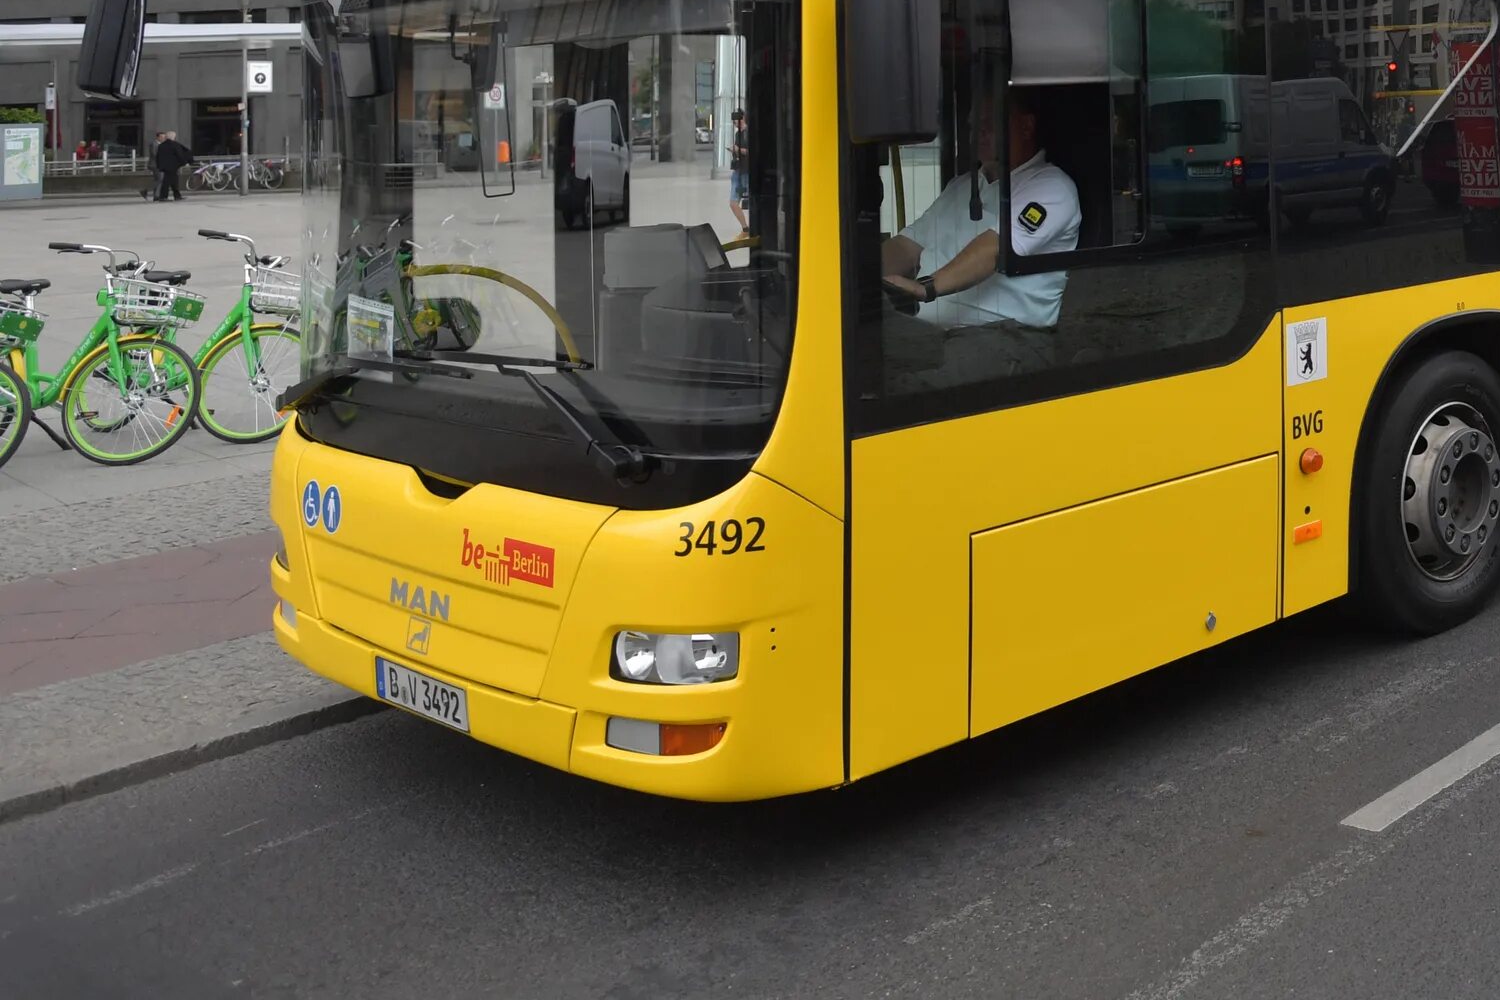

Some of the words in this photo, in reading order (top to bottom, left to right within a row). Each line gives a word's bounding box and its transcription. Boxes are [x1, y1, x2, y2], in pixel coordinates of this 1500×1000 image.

[1292, 410, 1323, 440] BVG
[461, 528, 485, 569] be
[512, 549, 550, 579] Berlin
[674, 516, 766, 557] 3492
[390, 577, 450, 621] MAN
[388, 666, 399, 698] B
[407, 673, 417, 706] V
[421, 680, 462, 724] 3492
